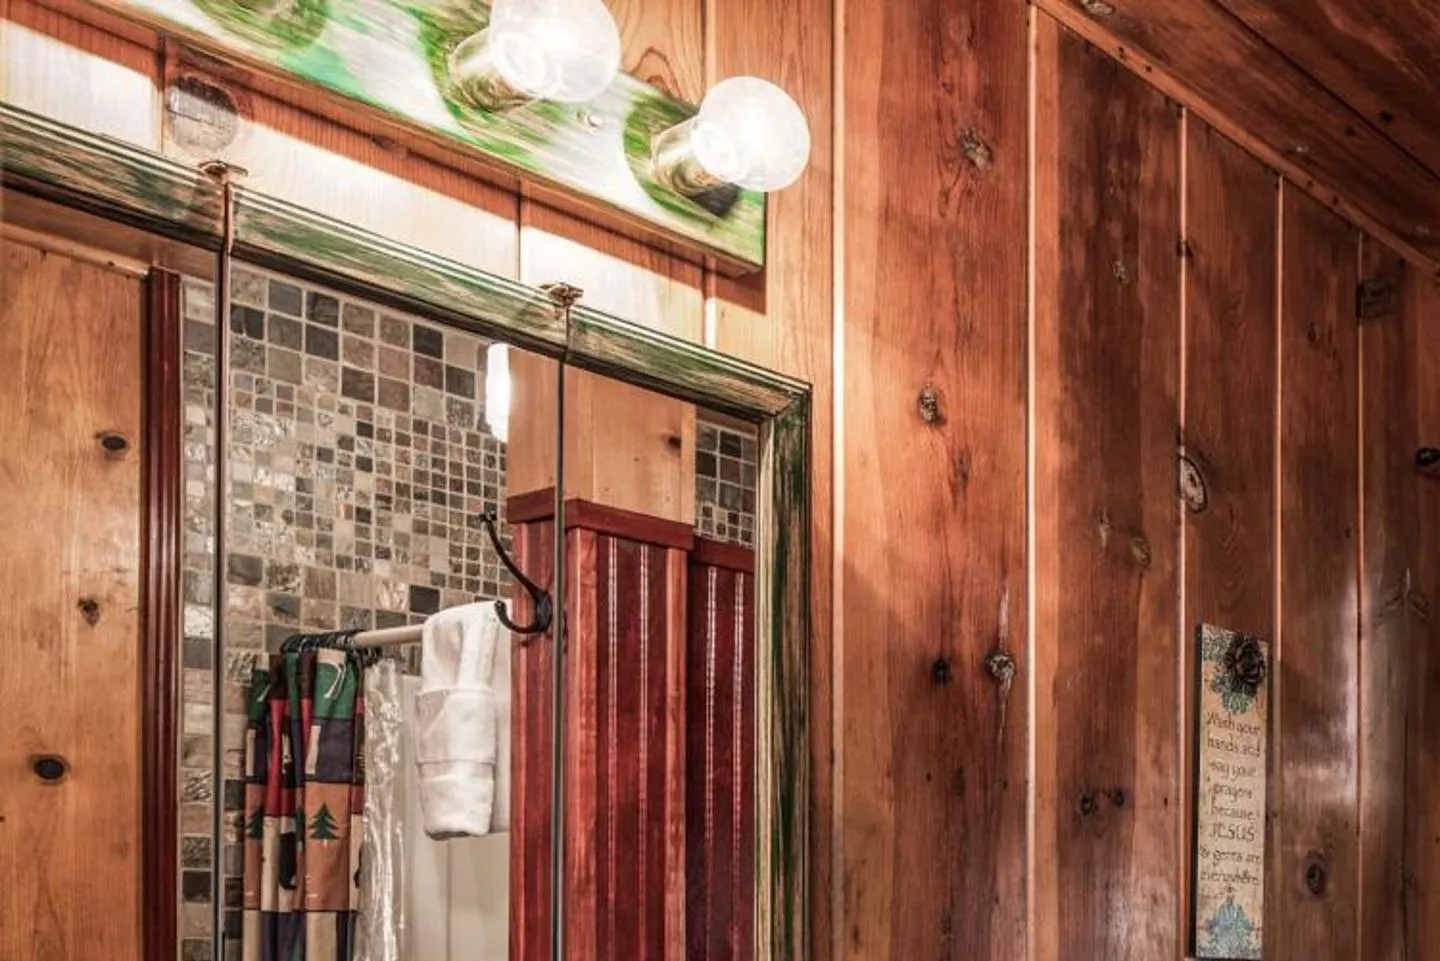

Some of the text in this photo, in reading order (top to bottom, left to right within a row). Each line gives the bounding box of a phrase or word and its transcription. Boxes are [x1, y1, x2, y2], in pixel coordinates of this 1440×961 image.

[1207, 728, 1261, 757] hands and
[1209, 822, 1255, 842] JESUS
